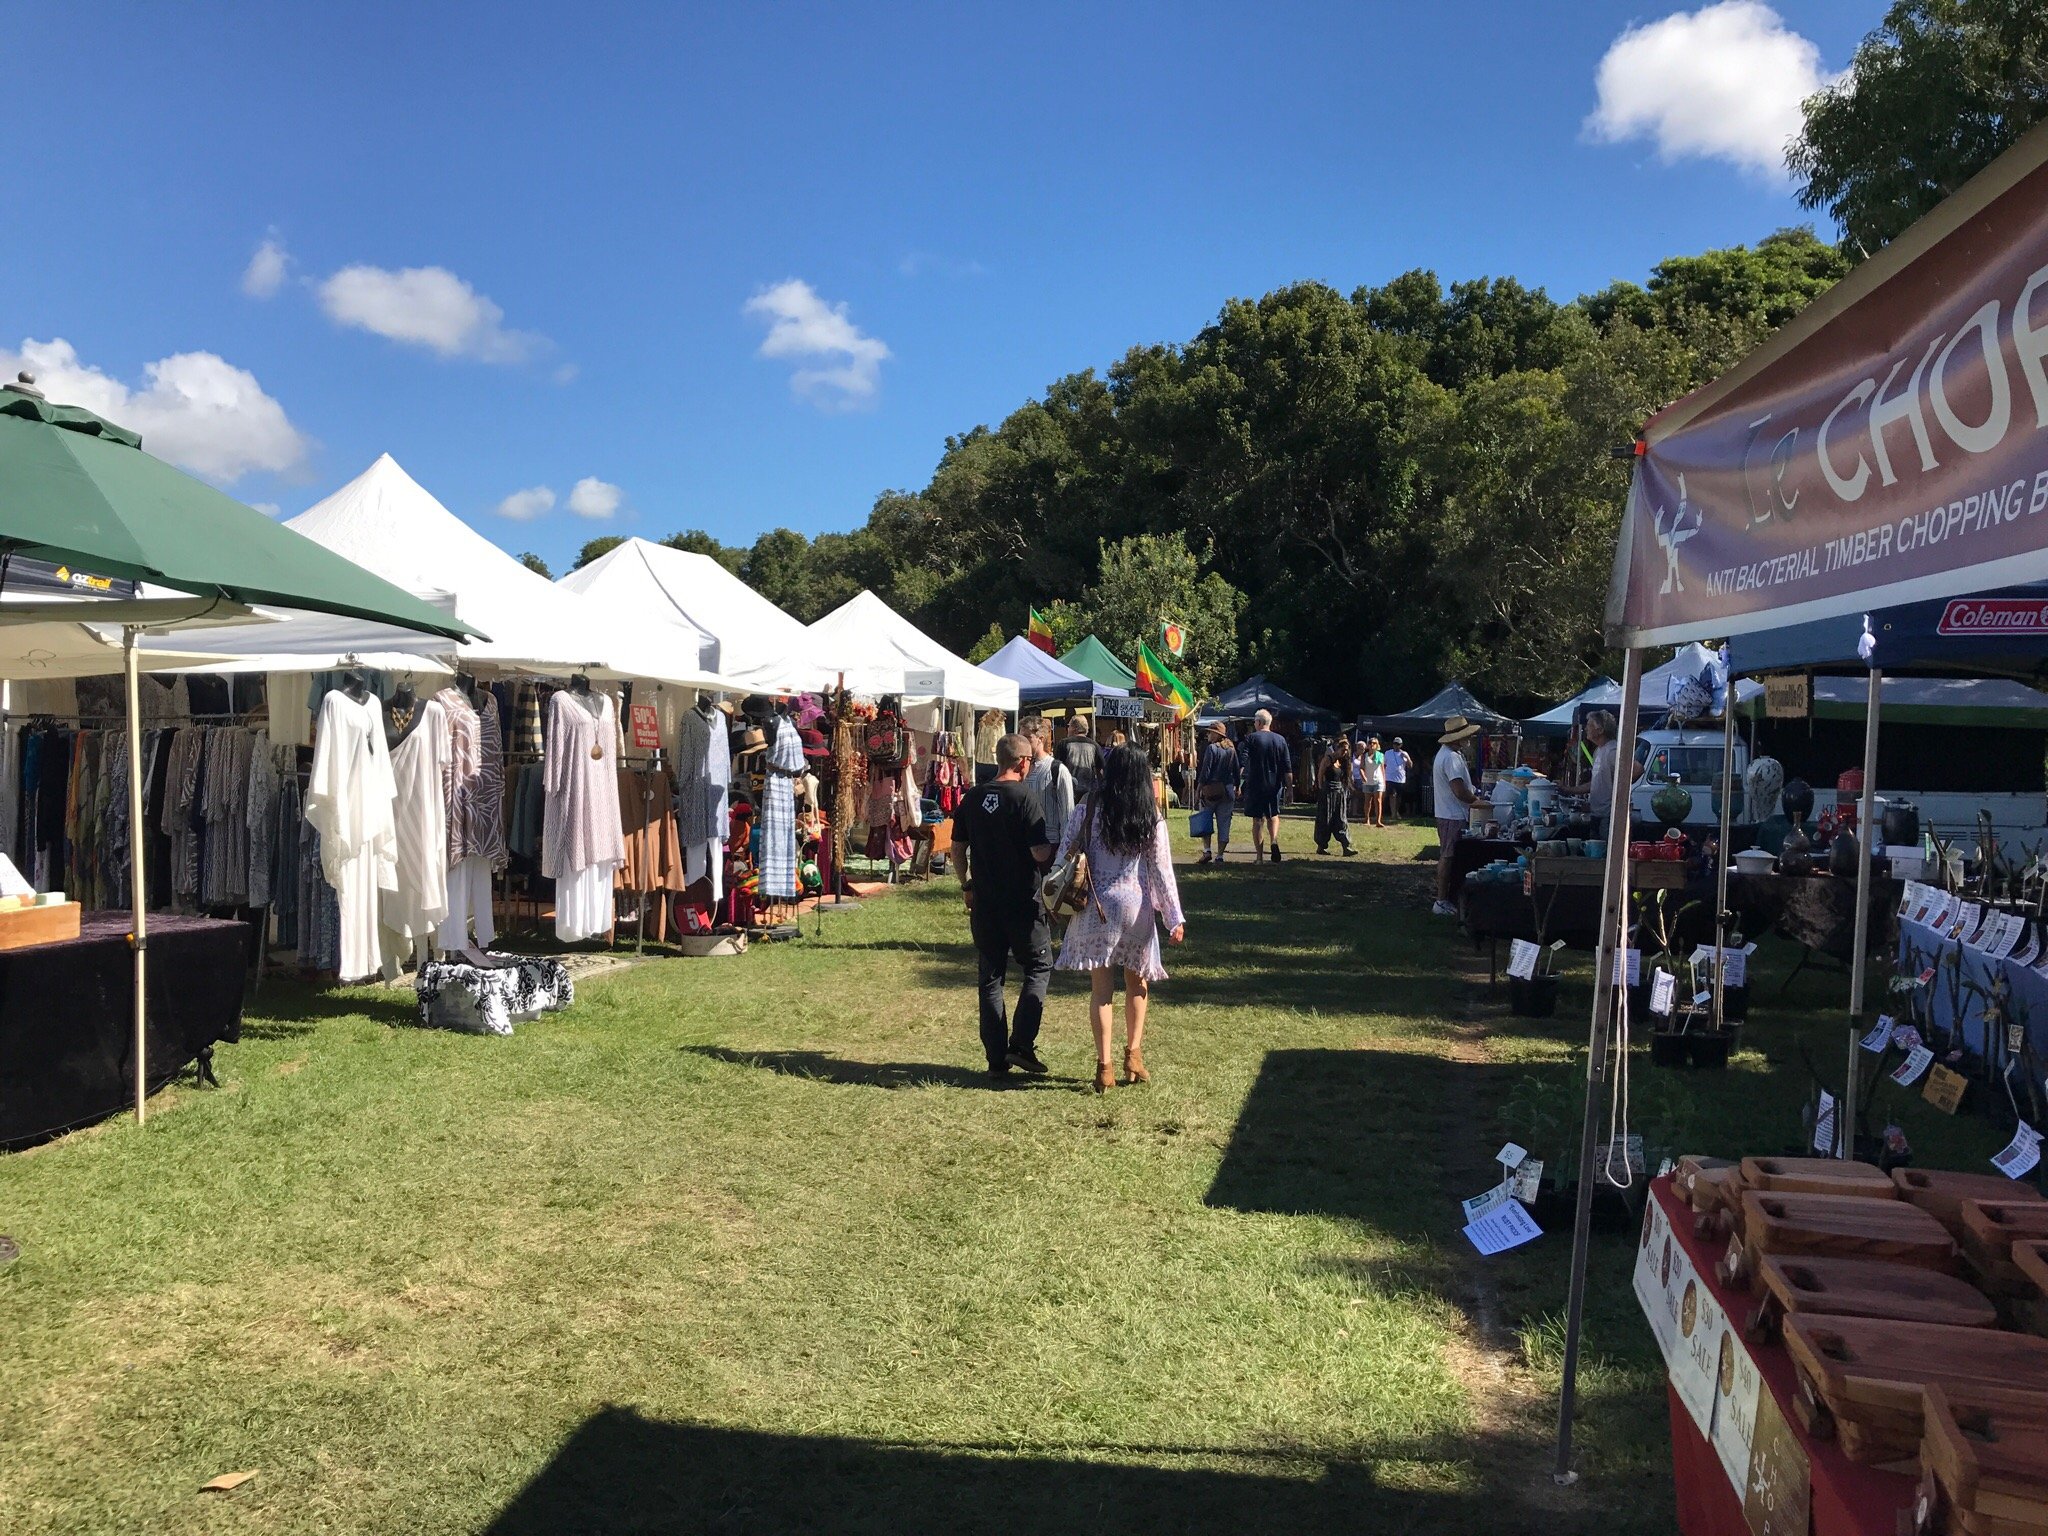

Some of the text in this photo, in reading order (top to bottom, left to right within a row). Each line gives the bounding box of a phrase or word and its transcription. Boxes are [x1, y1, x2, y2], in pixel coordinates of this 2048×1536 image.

[1705, 570, 1735, 598] ANTI
[1736, 546, 1820, 594] BACTERIAL
[1824, 522, 1893, 572] TIMBER
[1896, 479, 2026, 553] CHOPPING
[1949, 604, 2038, 627] Coleman
[633, 707, 656, 725] 50%
[1646, 1244, 1659, 1279] SALE
[1666, 1284, 1679, 1325] SALE
[1702, 1298, 1713, 1331] $30
[1691, 1334, 1713, 1380] SALE
[1739, 1356, 1752, 1395] $40
[1730, 1395, 1753, 1451] SALE
